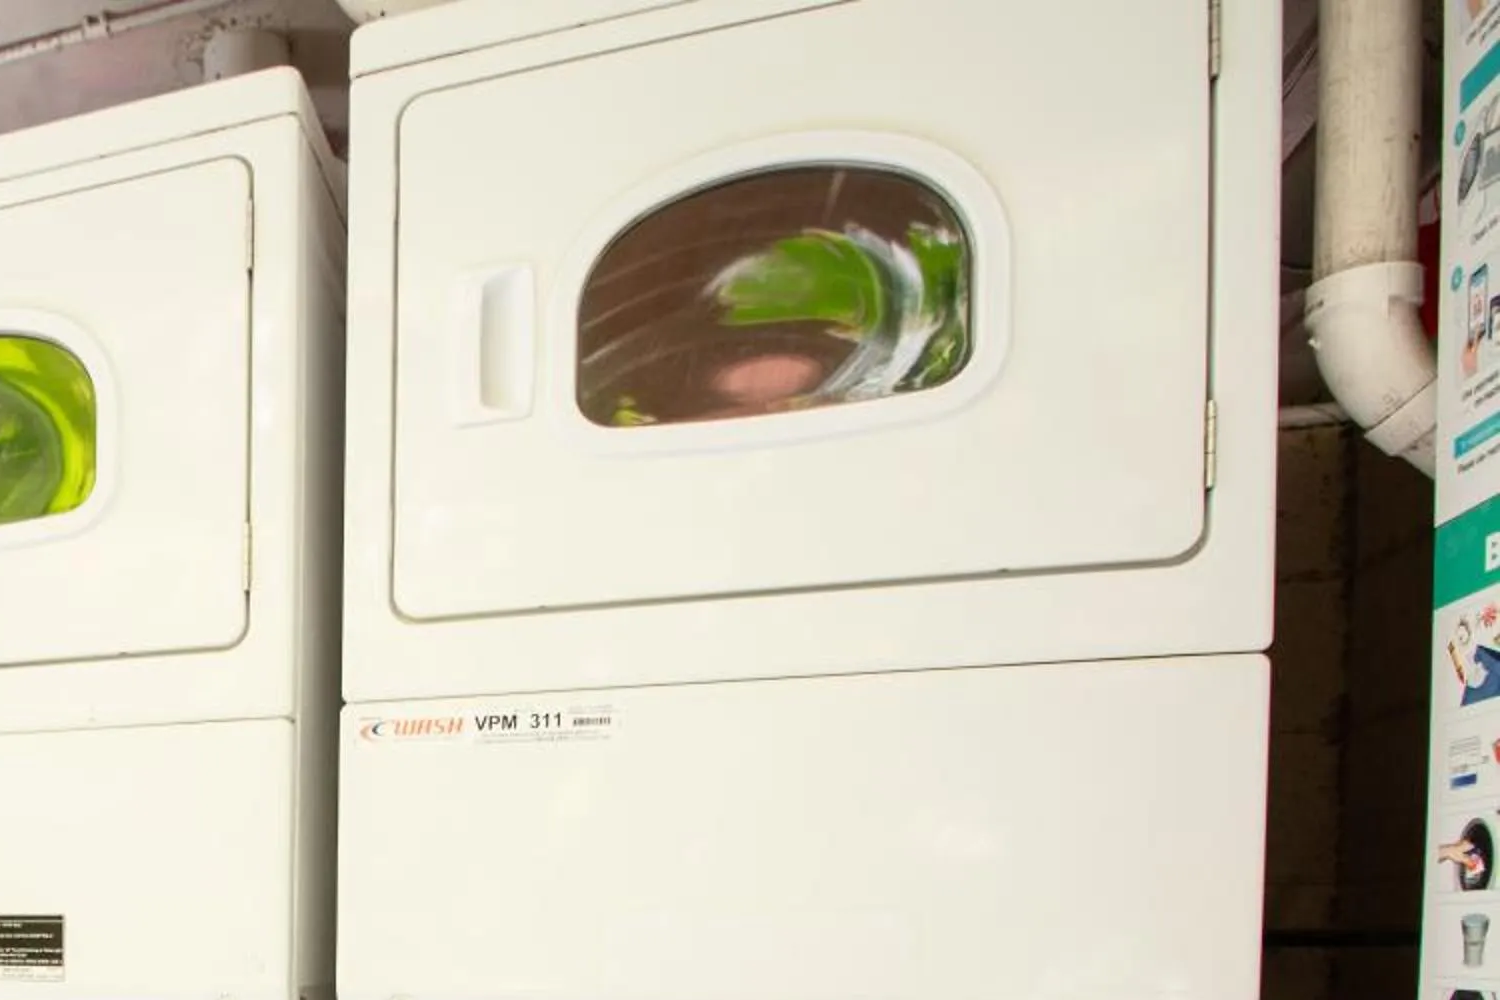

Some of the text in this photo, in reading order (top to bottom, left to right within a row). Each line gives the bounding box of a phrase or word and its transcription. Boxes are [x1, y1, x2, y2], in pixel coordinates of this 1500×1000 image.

[394, 716, 464, 737] WASH
[474, 714, 518, 731] VPM
[530, 711, 562, 729] 311
